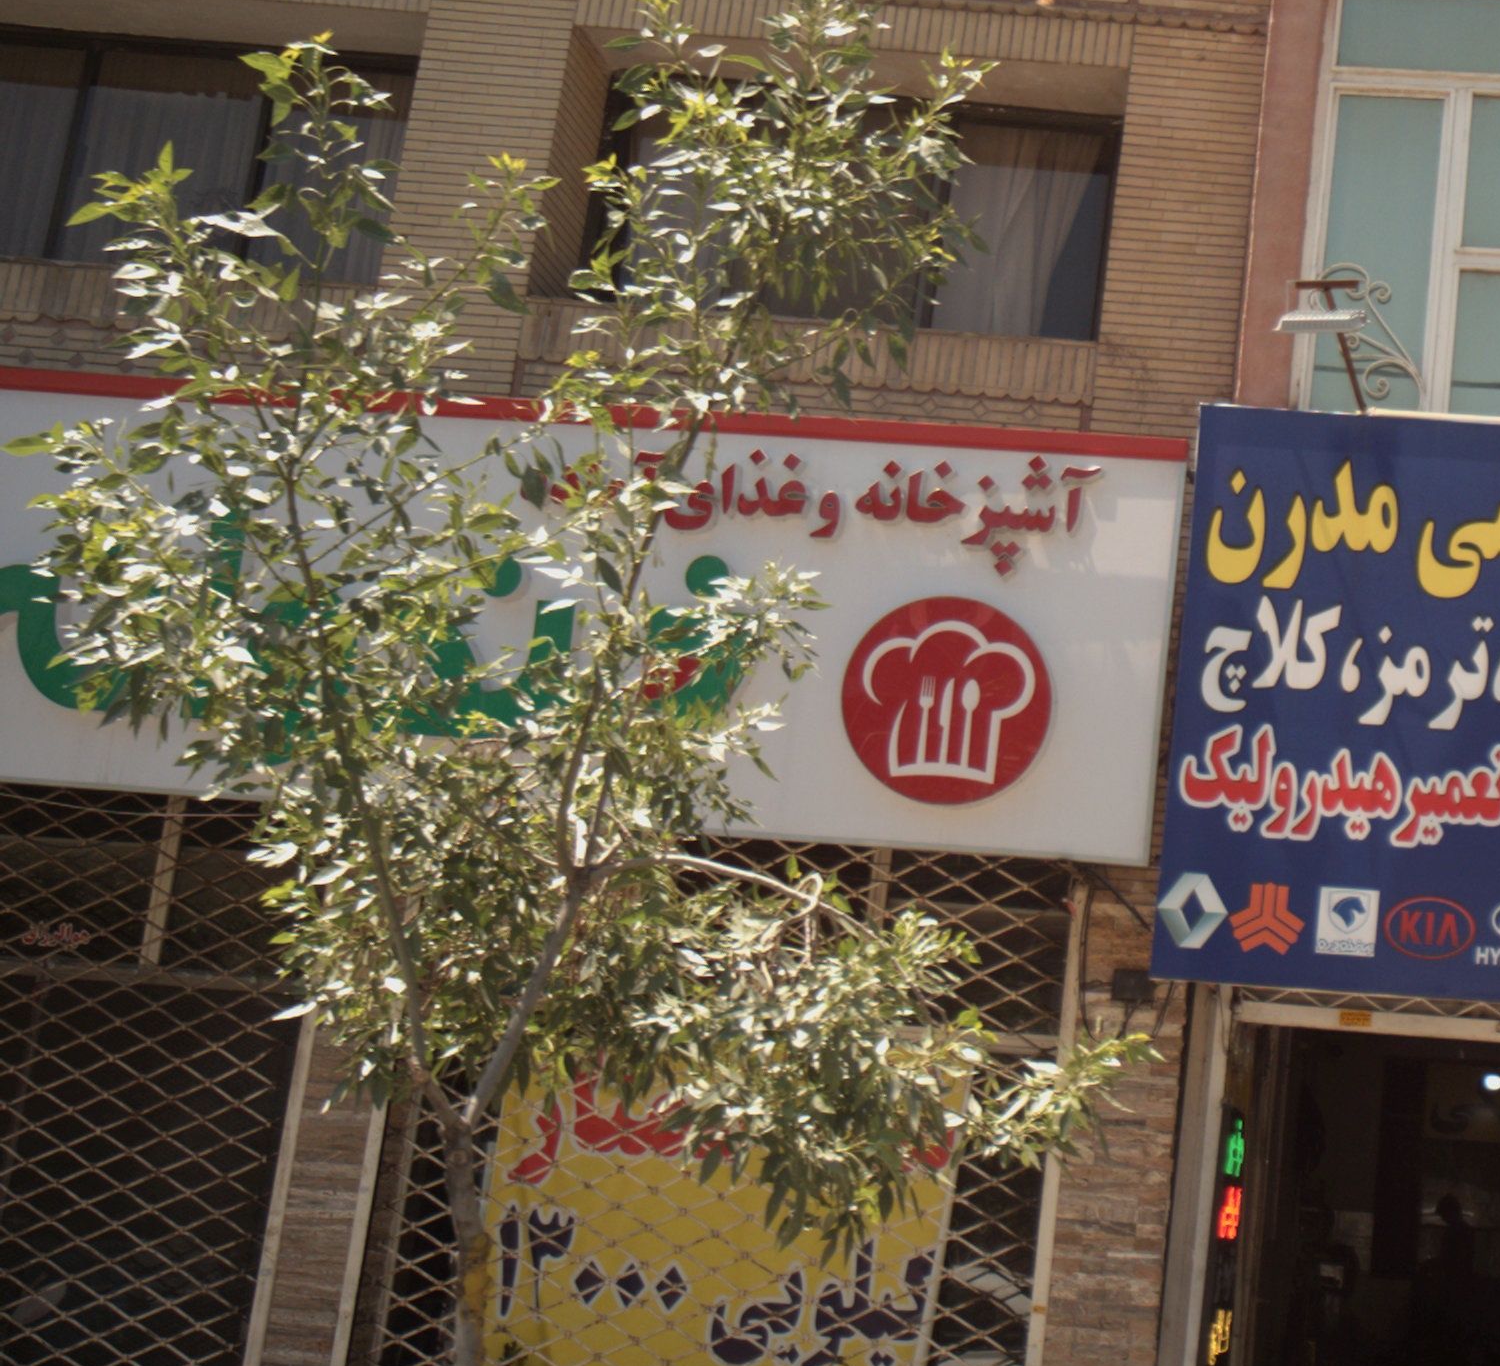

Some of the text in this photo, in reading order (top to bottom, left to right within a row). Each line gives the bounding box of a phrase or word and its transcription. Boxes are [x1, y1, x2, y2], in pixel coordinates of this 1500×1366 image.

[661, 448, 808, 533] غذای
[809, 490, 840, 538] و
[855, 455, 1102, 577] آشپزخانه
[1205, 459, 1399, 590] مدرن
[1200, 594, 1343, 713] کلاچ
[1178, 723, 1401, 842] هیدرولیک
[1399, 910, 1460, 947] KIA
